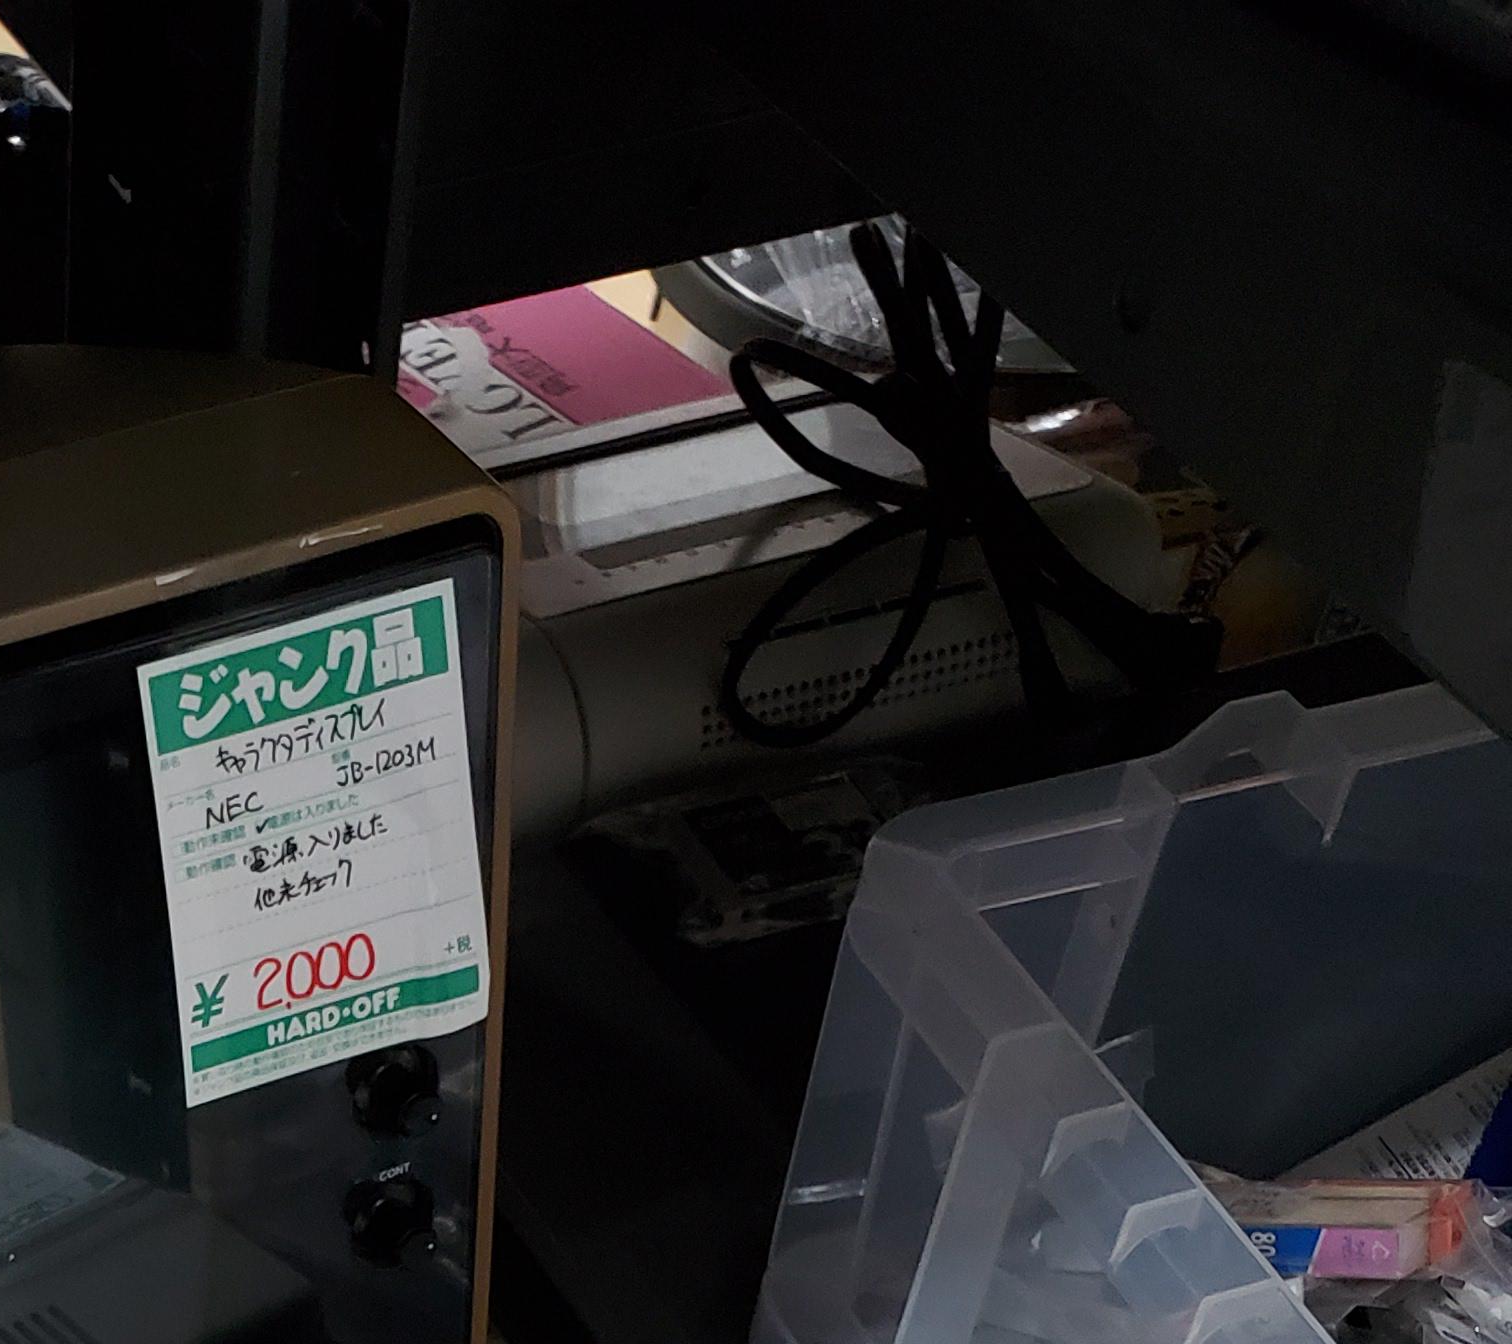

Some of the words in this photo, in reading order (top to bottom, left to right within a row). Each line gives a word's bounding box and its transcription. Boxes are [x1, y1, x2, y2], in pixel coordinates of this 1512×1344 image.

[178, 607, 424, 739] ジャンク品
[337, 737, 435, 787] JB-1203M
[207, 792, 263, 829] NEC
[191, 973, 229, 1028] ¥
[378, 1161, 411, 1182] CONT
